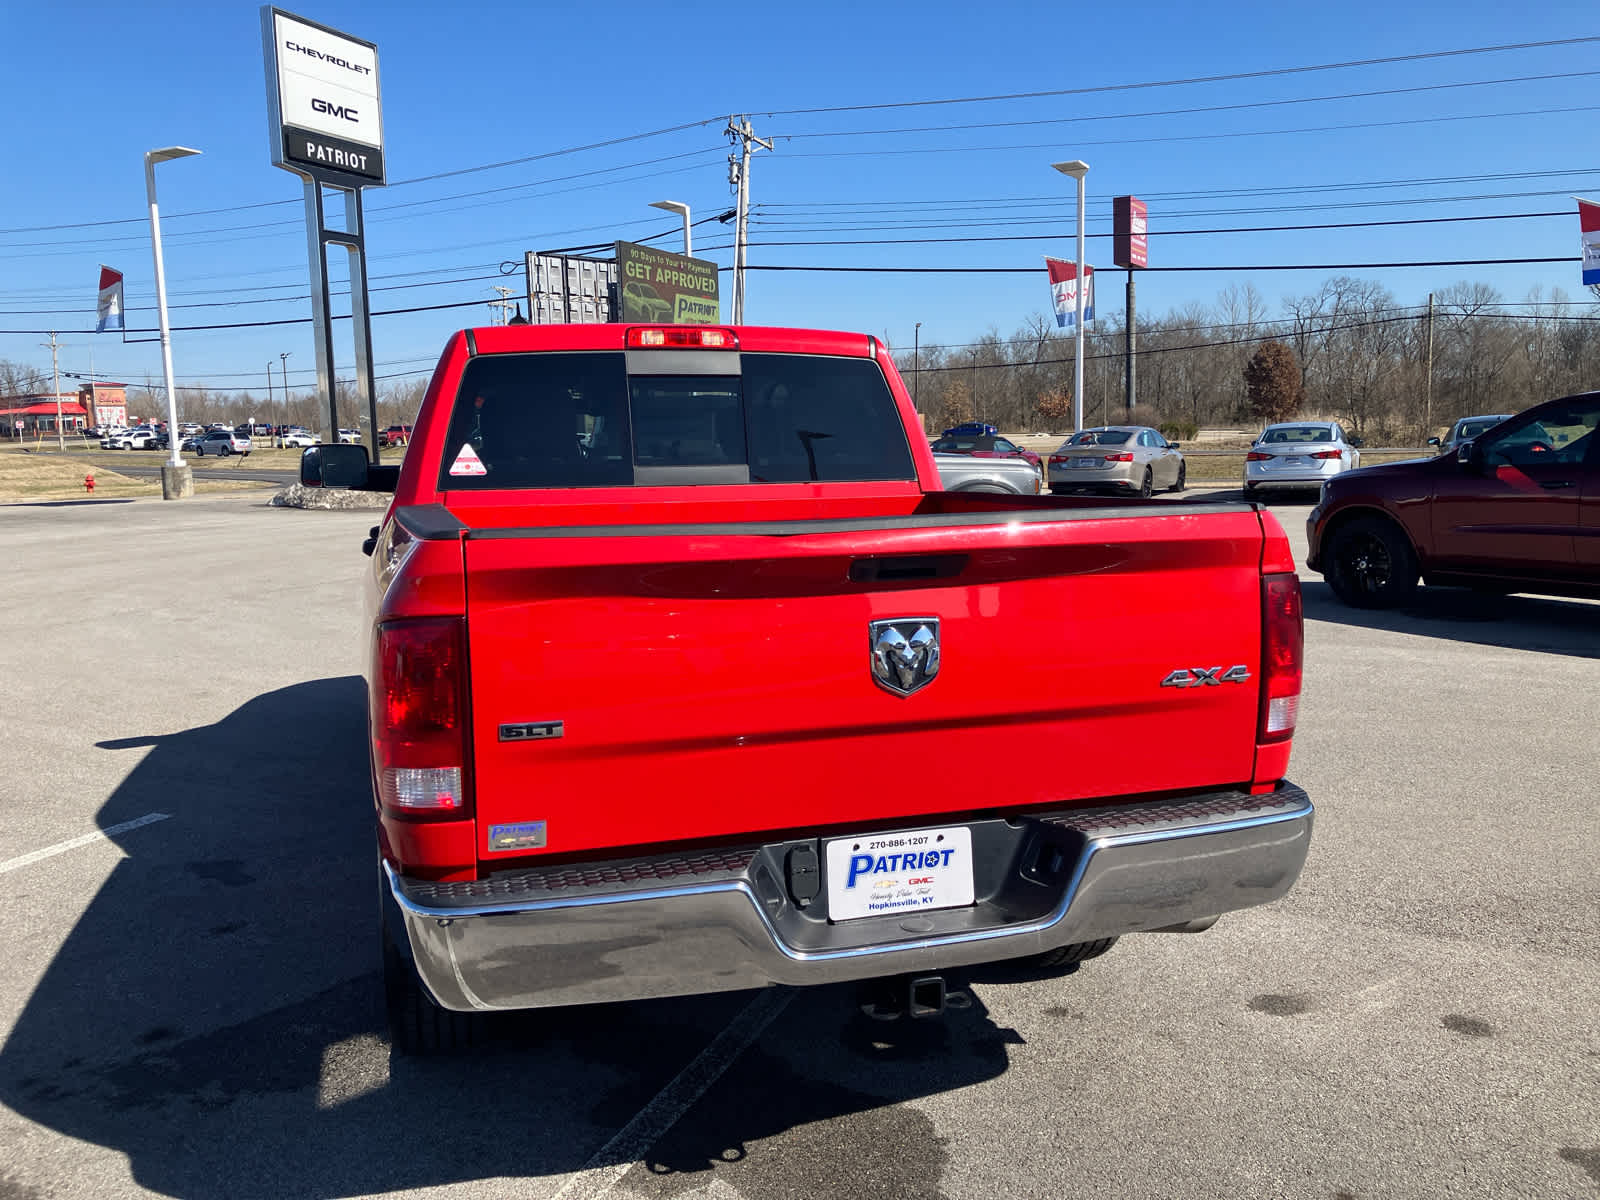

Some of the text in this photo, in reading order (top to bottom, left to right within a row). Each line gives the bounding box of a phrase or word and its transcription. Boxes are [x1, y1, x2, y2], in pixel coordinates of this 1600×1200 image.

[286, 40, 371, 75] CHEVROLET
[311, 98, 359, 122] GMC
[306, 142, 367, 170] PATRIOT
[640, 251, 656, 263] Days
[625, 260, 716, 293] GET APPROVED
[678, 298, 717, 319] PATRIOT
[500, 721, 564, 741] SLT
[870, 836, 929, 849] 270-886-1207
[846, 849, 955, 888] PATRIOT
[908, 876, 935, 885] GMC
[868, 896, 934, 910] Hopkinsville, KY
